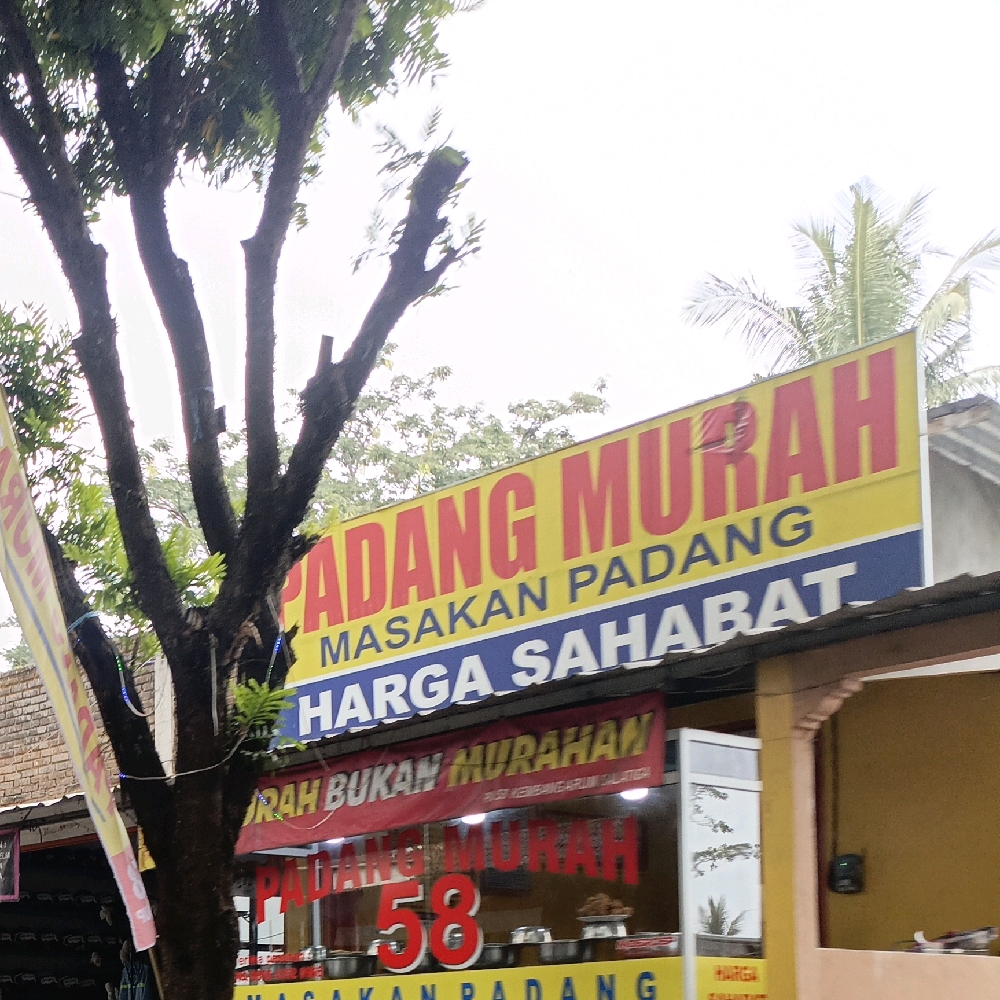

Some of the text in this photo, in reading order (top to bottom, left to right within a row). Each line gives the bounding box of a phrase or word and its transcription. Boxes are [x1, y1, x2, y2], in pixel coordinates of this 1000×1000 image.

[561, 347, 898, 561] MURAH
[298, 562, 858, 736] HARGA SAHABAT
[320, 505, 815, 668] MASAKAN PADANG
[323, 753, 444, 811] BUKAN
[447, 711, 656, 788] MURAHAN
[256, 828, 424, 924] PADANG
[443, 815, 640, 885] MURAH
[377, 873, 484, 974] 58
